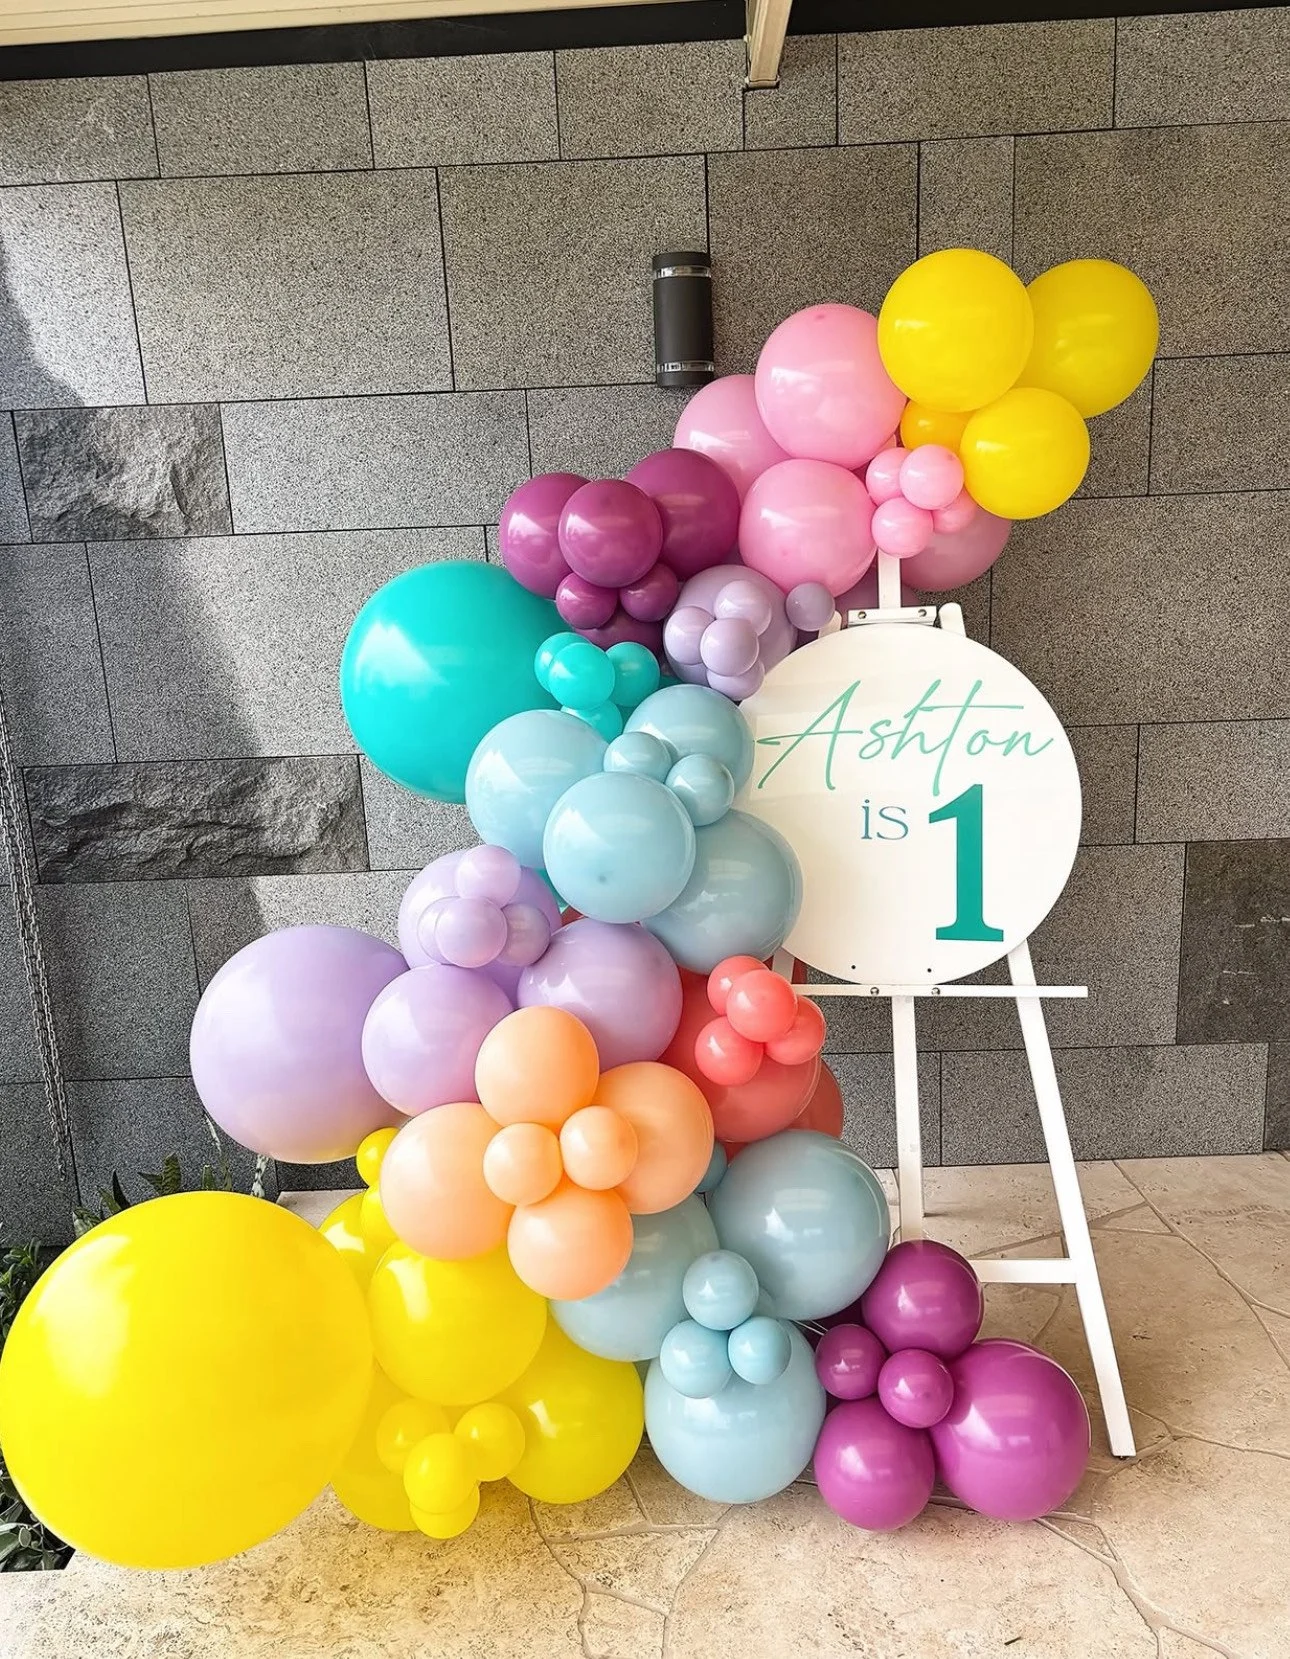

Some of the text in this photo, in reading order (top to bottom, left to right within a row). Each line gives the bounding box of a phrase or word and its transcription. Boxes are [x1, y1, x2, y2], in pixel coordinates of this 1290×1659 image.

[756, 679, 1054, 796] Ashton
[861, 783, 1004, 942] is 1
